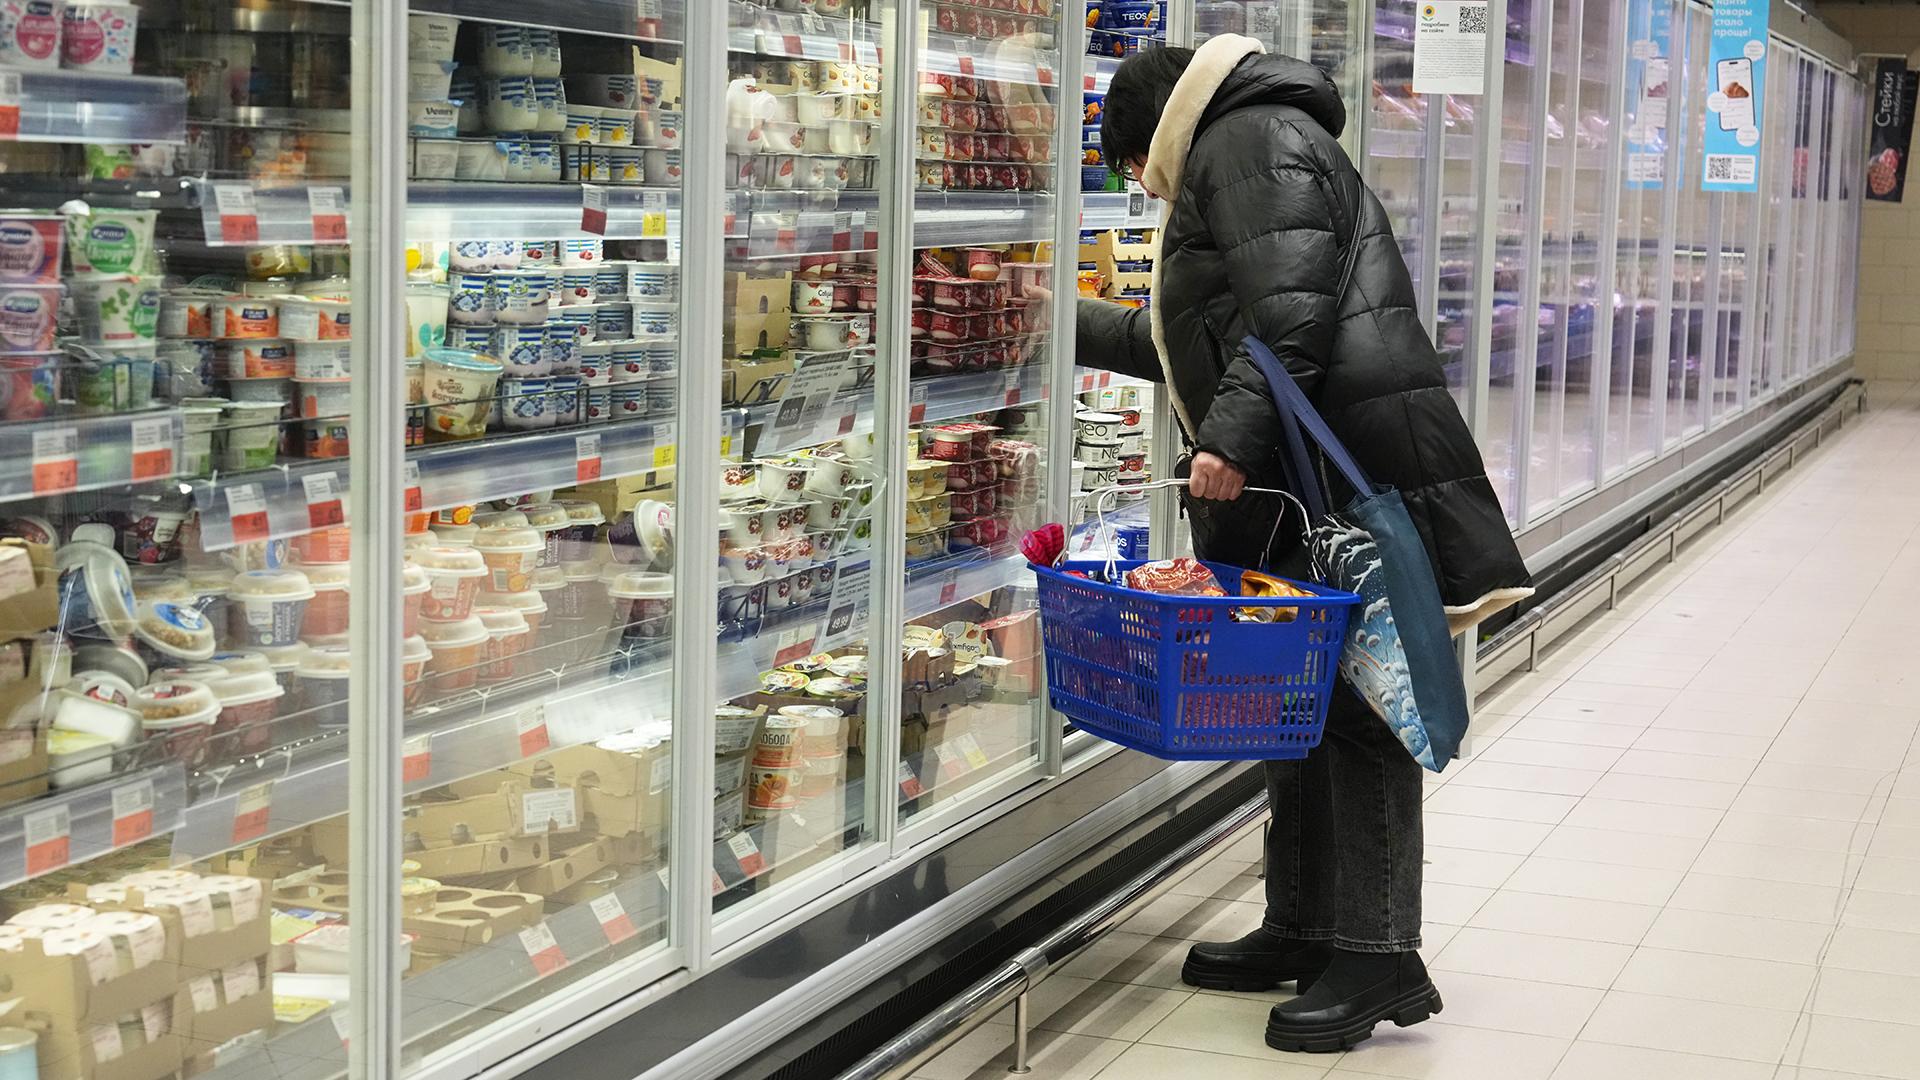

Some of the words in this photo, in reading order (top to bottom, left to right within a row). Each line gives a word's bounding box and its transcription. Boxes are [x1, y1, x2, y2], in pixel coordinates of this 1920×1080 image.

[1715, 8, 1752, 17] товары
[1713, 27, 1752, 37] проще!
[1875, 72, 1894, 127] Стейки
[1102, 447, 1120, 459] Ne
[1097, 470, 1117, 482] Ne
[761, 733, 790, 745] ОБОДА
